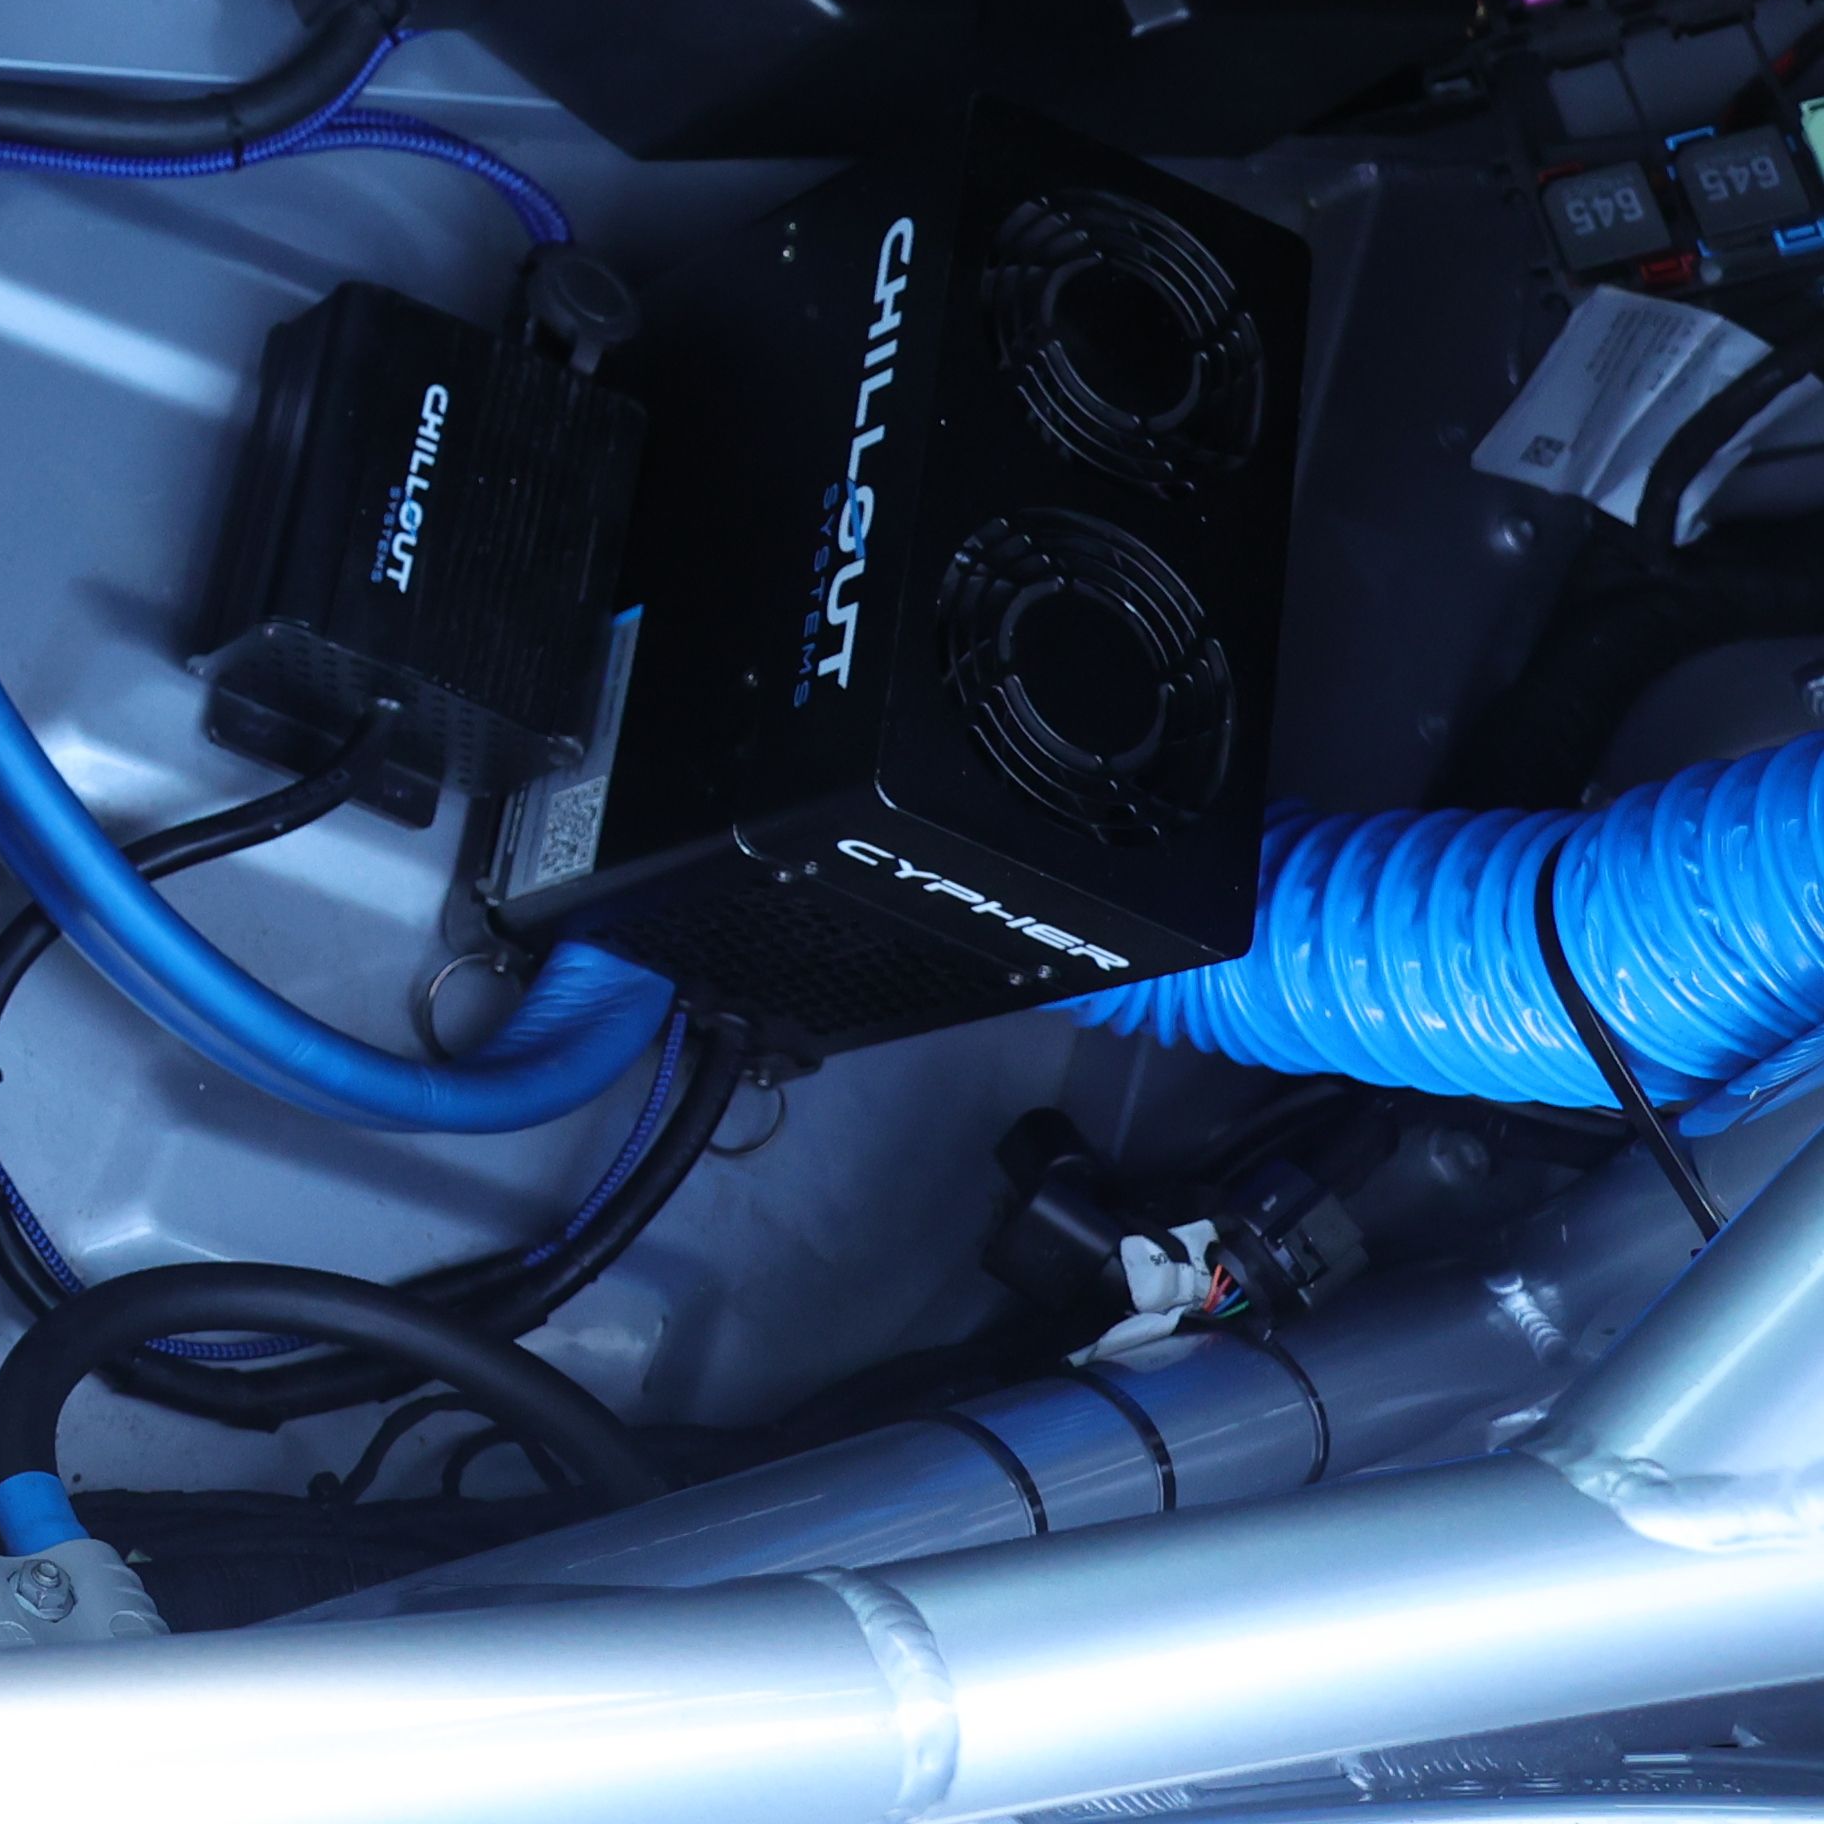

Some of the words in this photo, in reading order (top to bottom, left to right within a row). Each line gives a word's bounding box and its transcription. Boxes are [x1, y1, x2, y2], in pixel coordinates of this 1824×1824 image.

[386, 384, 449, 594] CHILLOUT
[816, 217, 915, 690] CHILLOUT
[793, 481, 838, 709] SYSTEMS
[837, 839, 1131, 972] CYPHER
